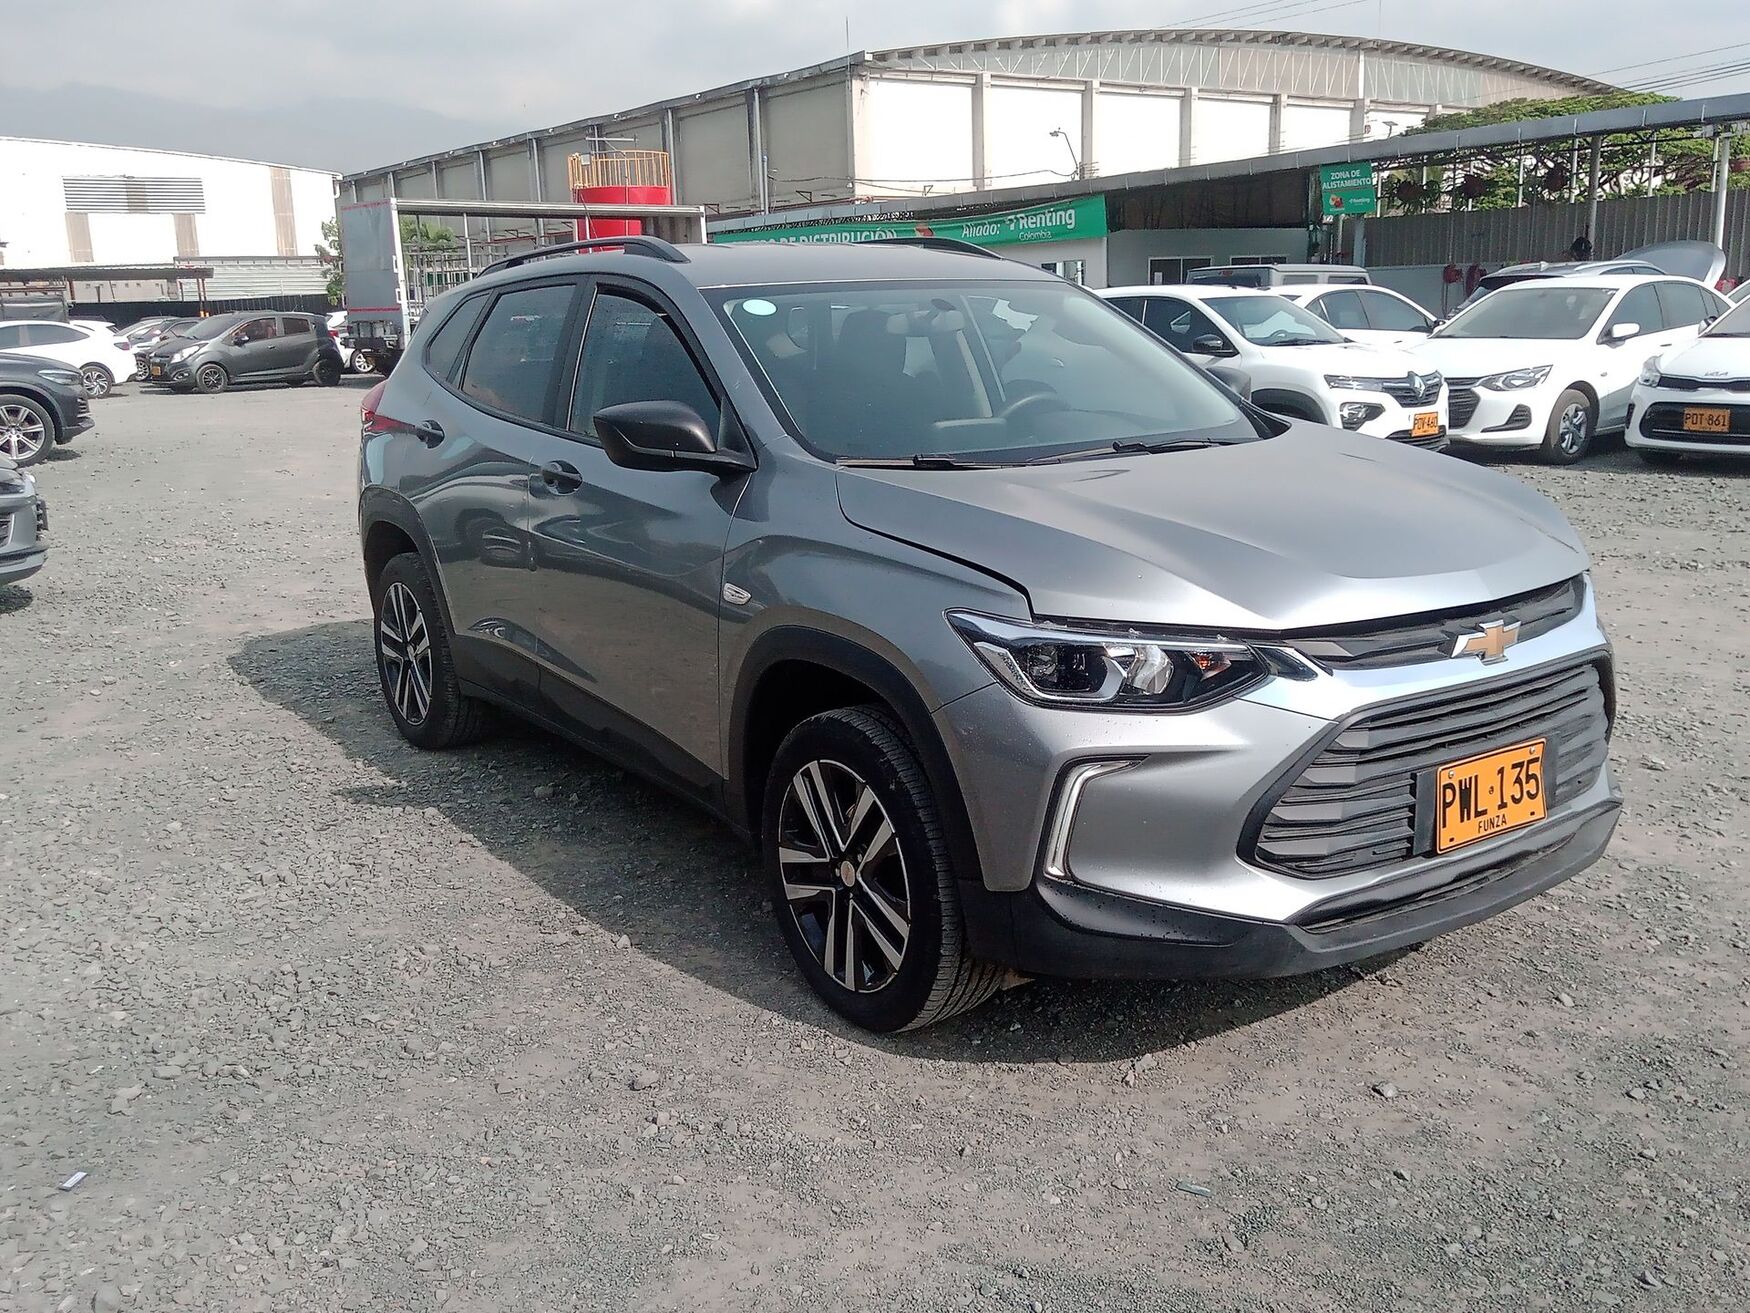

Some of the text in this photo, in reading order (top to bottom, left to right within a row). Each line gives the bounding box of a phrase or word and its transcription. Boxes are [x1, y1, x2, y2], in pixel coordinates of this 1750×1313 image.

[1330, 170, 1360, 180] ZONA DE
[1322, 178, 1371, 190] ALISTAMIENTO
[961, 207, 1076, 239] Aliado: Renting
[1018, 229, 1052, 241] Colombia
[1442, 757, 1541, 829] PWL 135
[1477, 813, 1508, 834] FUNZA
